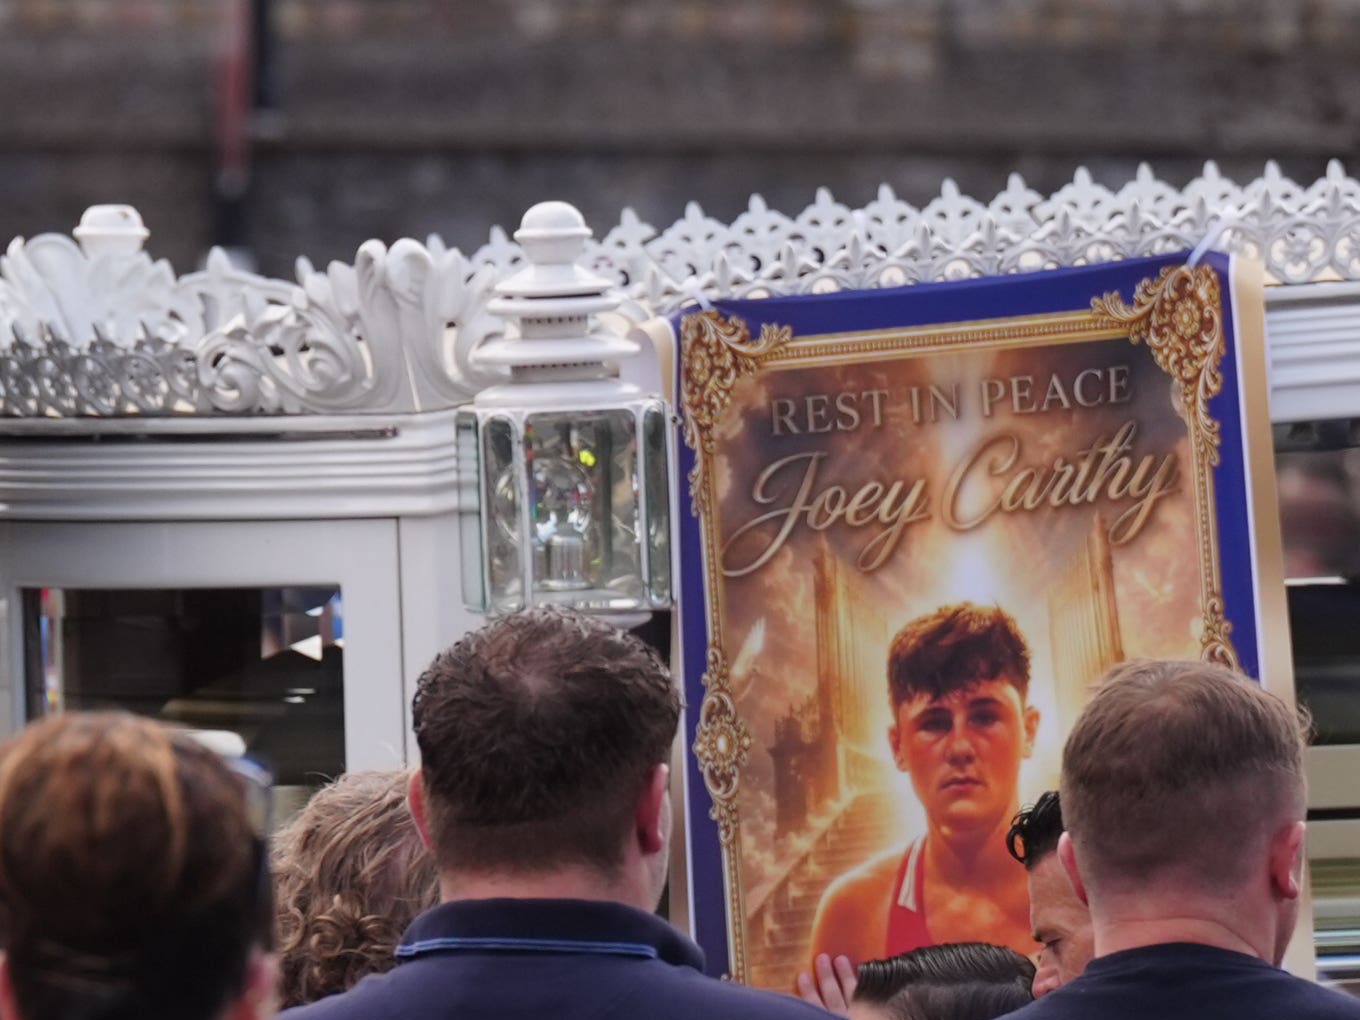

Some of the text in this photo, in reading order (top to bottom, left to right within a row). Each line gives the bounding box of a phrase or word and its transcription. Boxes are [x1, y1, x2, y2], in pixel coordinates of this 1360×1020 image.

[770, 365, 1132, 437] REST IN PEACE
[721, 420, 1182, 578] Joey Carthy
